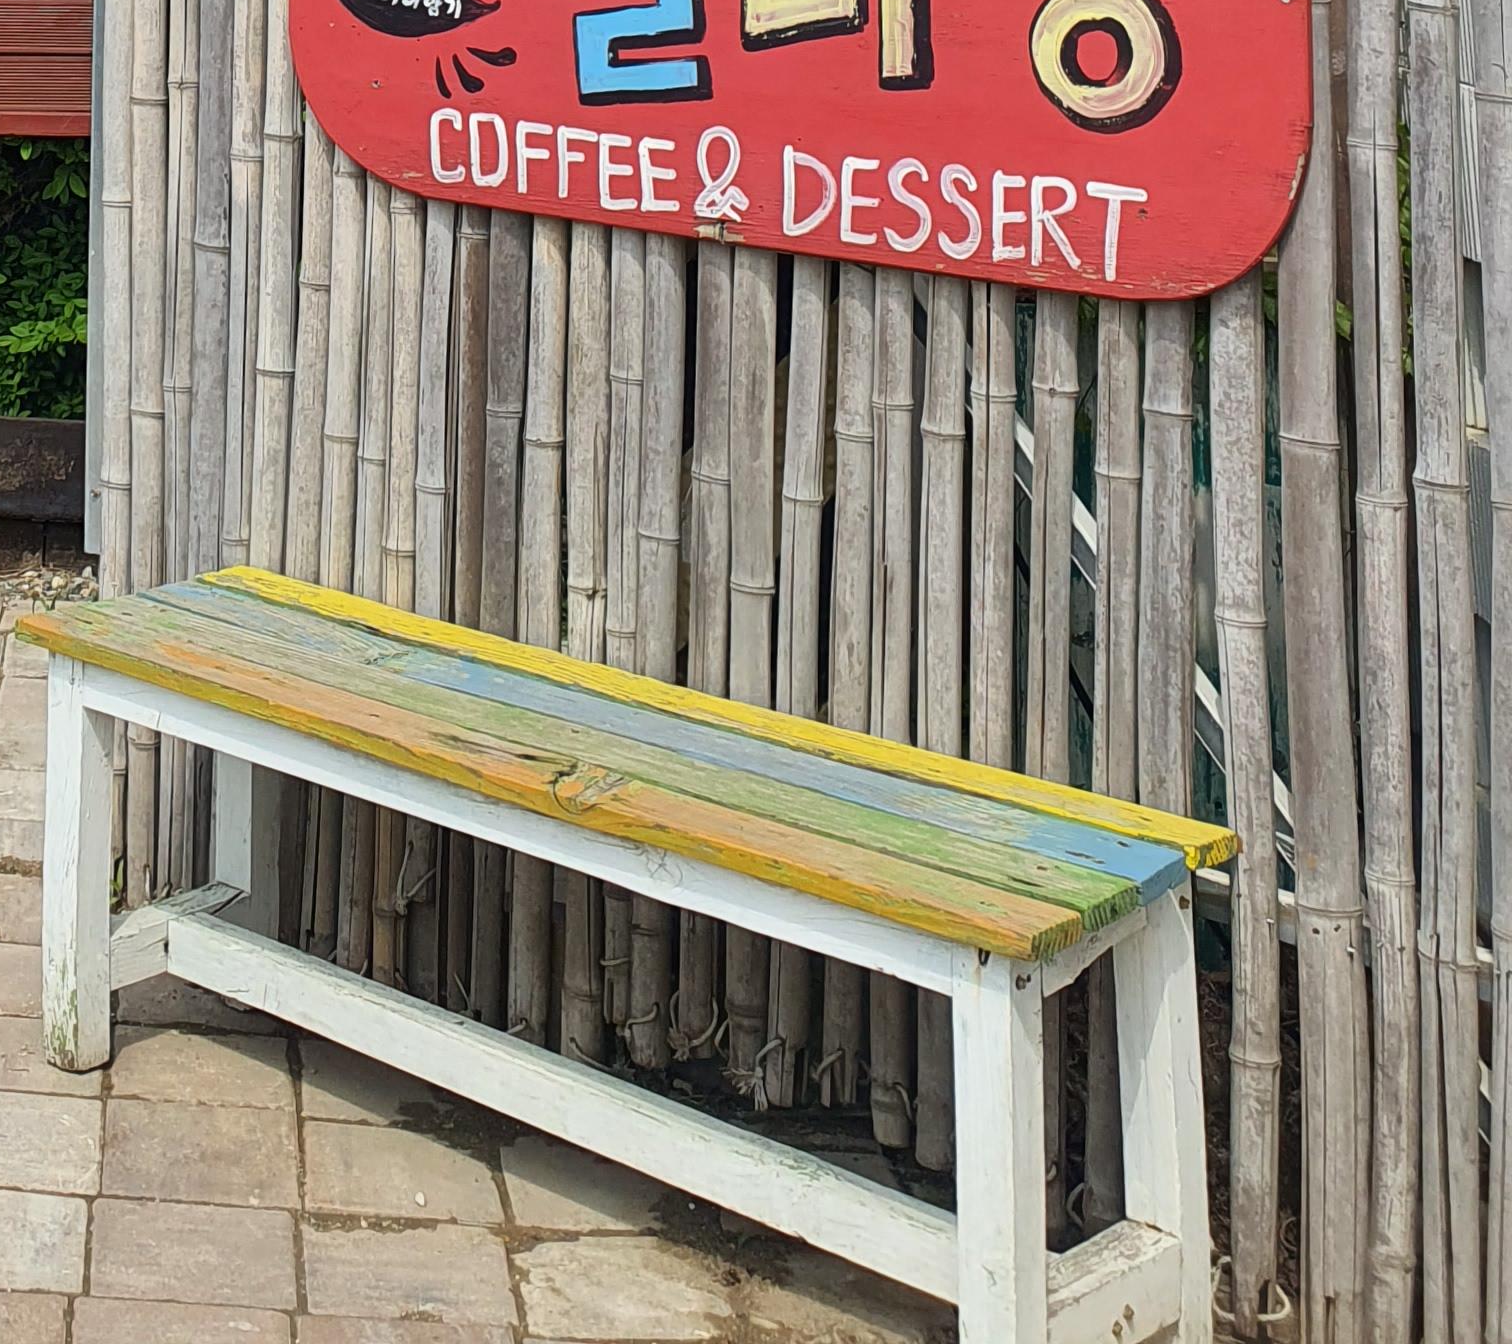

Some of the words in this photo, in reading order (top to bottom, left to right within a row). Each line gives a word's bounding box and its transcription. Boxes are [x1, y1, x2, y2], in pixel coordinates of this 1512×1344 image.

[429, 109, 681, 212] COFFEE
[693, 124, 751, 223] &
[782, 144, 1149, 282] DESSERT
